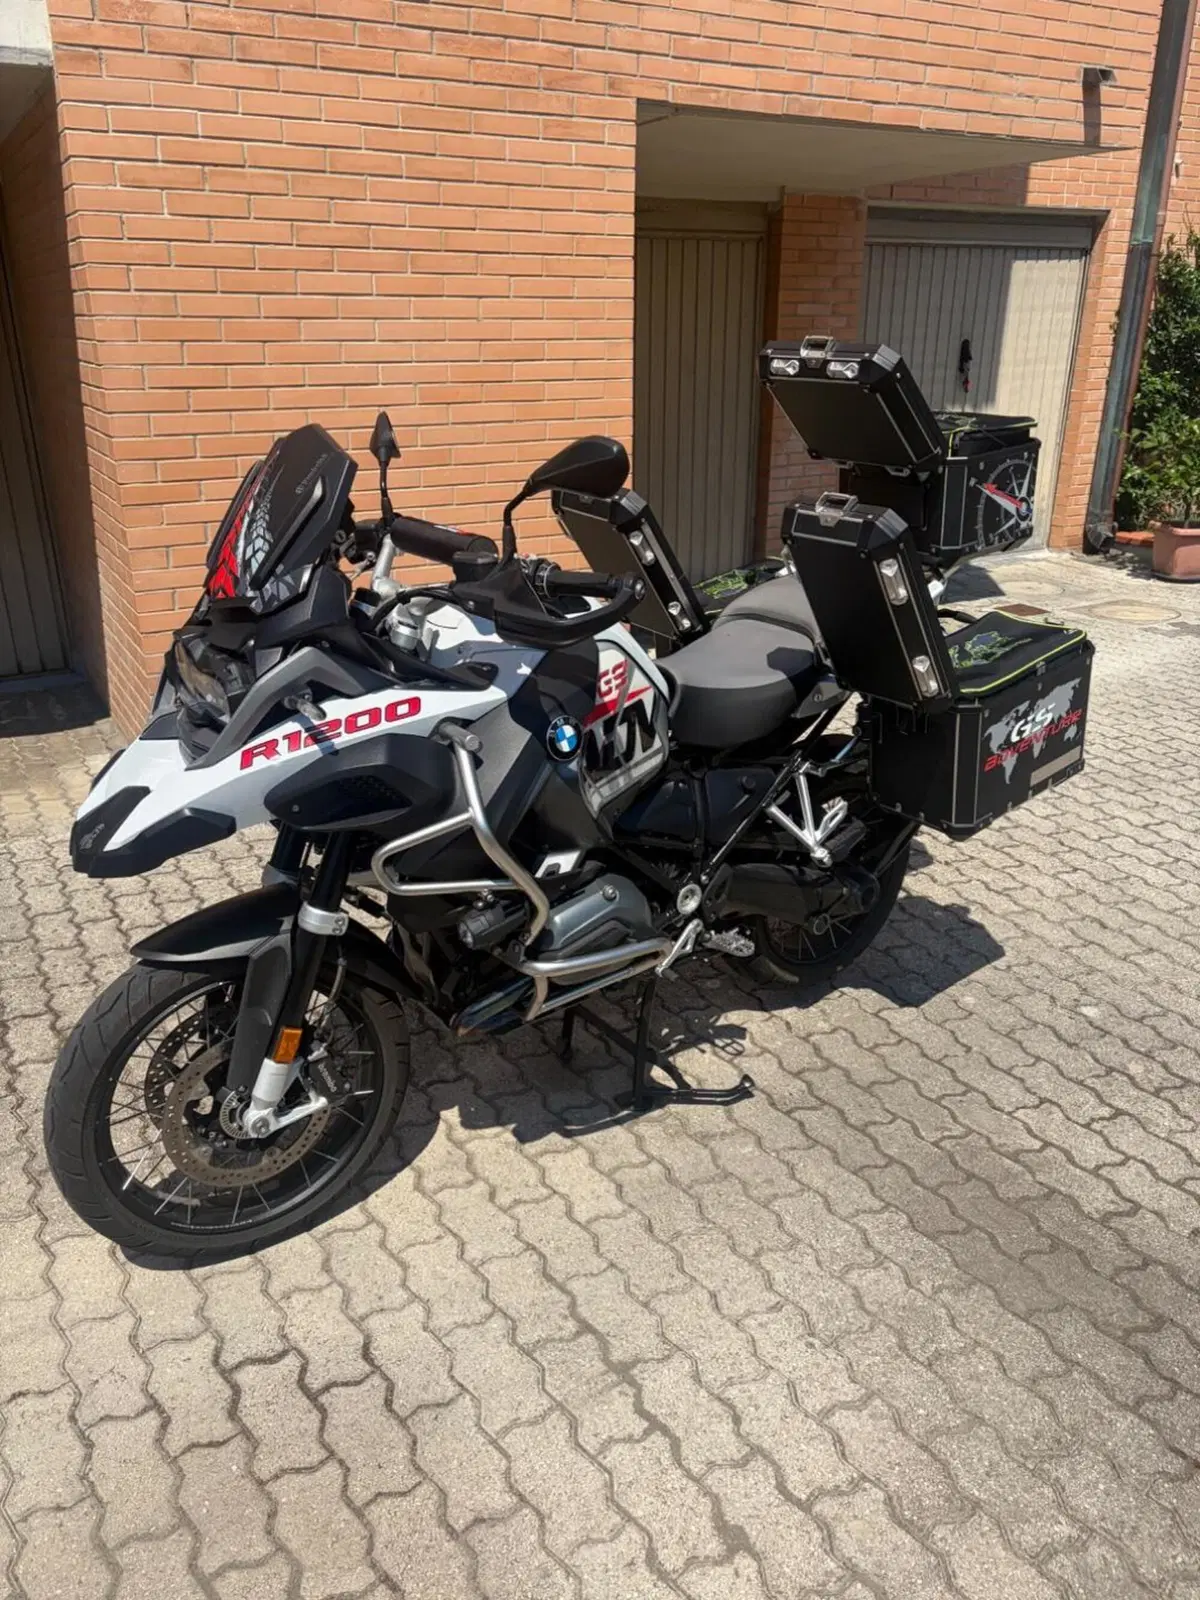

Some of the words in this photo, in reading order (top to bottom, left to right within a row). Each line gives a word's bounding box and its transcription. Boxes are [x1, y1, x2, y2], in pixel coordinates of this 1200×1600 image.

[240, 696, 421, 770] R1200
[1010, 702, 1056, 743] GS
[317, 1061, 338, 1093] brembo
